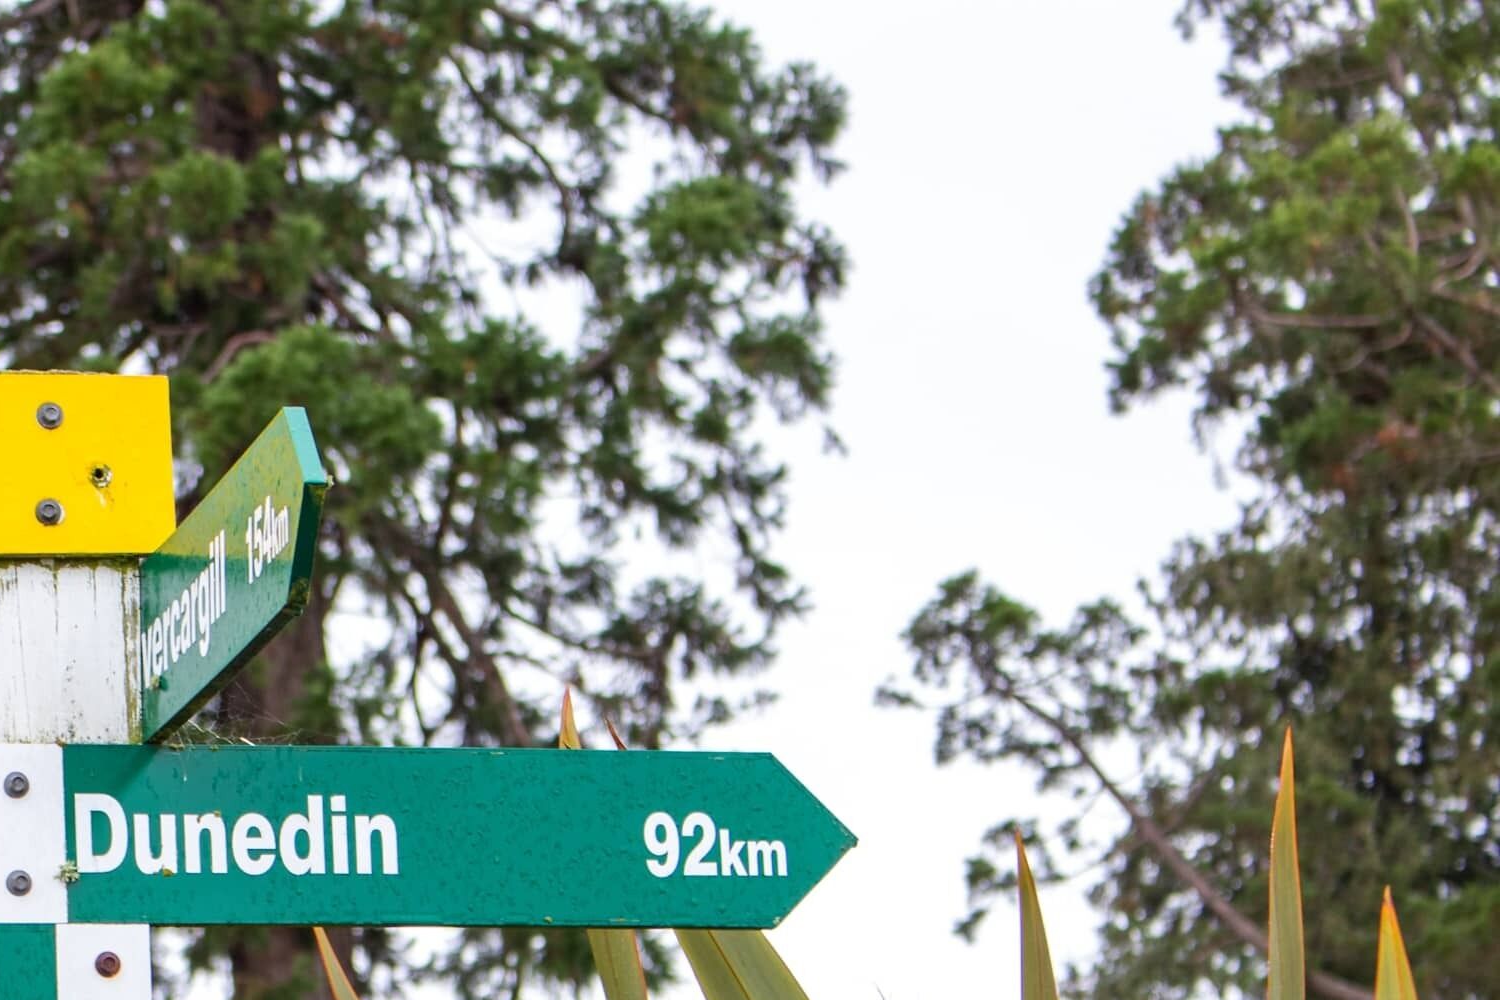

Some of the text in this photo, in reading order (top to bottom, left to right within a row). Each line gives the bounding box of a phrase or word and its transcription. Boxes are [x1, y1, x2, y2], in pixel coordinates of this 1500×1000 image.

[141, 495, 290, 689] vercargill 154km
[73, 793, 788, 878] Dunedin 92km
